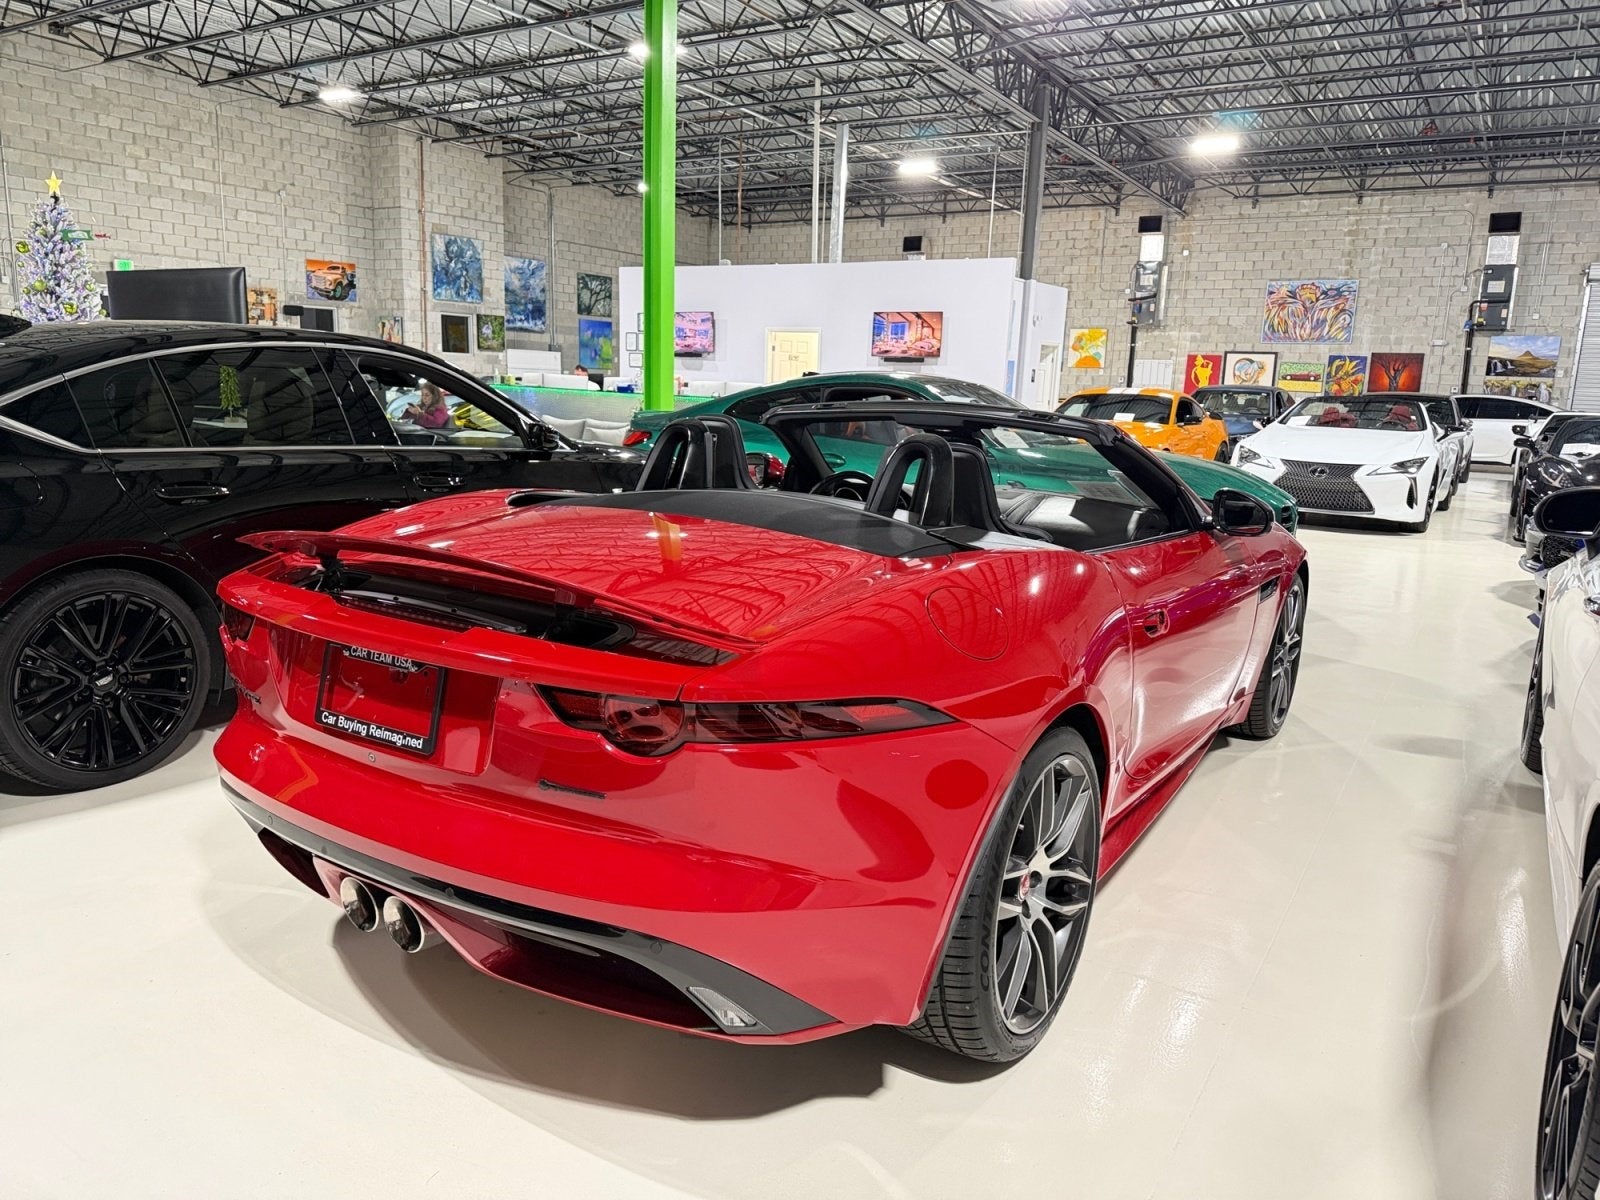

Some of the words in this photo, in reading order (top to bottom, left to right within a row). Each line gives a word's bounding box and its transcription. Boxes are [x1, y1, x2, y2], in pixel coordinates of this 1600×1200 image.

[350, 645, 367, 658] CAR
[369, 650, 392, 664] TEAM
[394, 656, 412, 668] USA
[321, 711, 336, 725] Car
[337, 715, 367, 737] Buying
[980, 776, 1030, 993] CONTINENTAL
